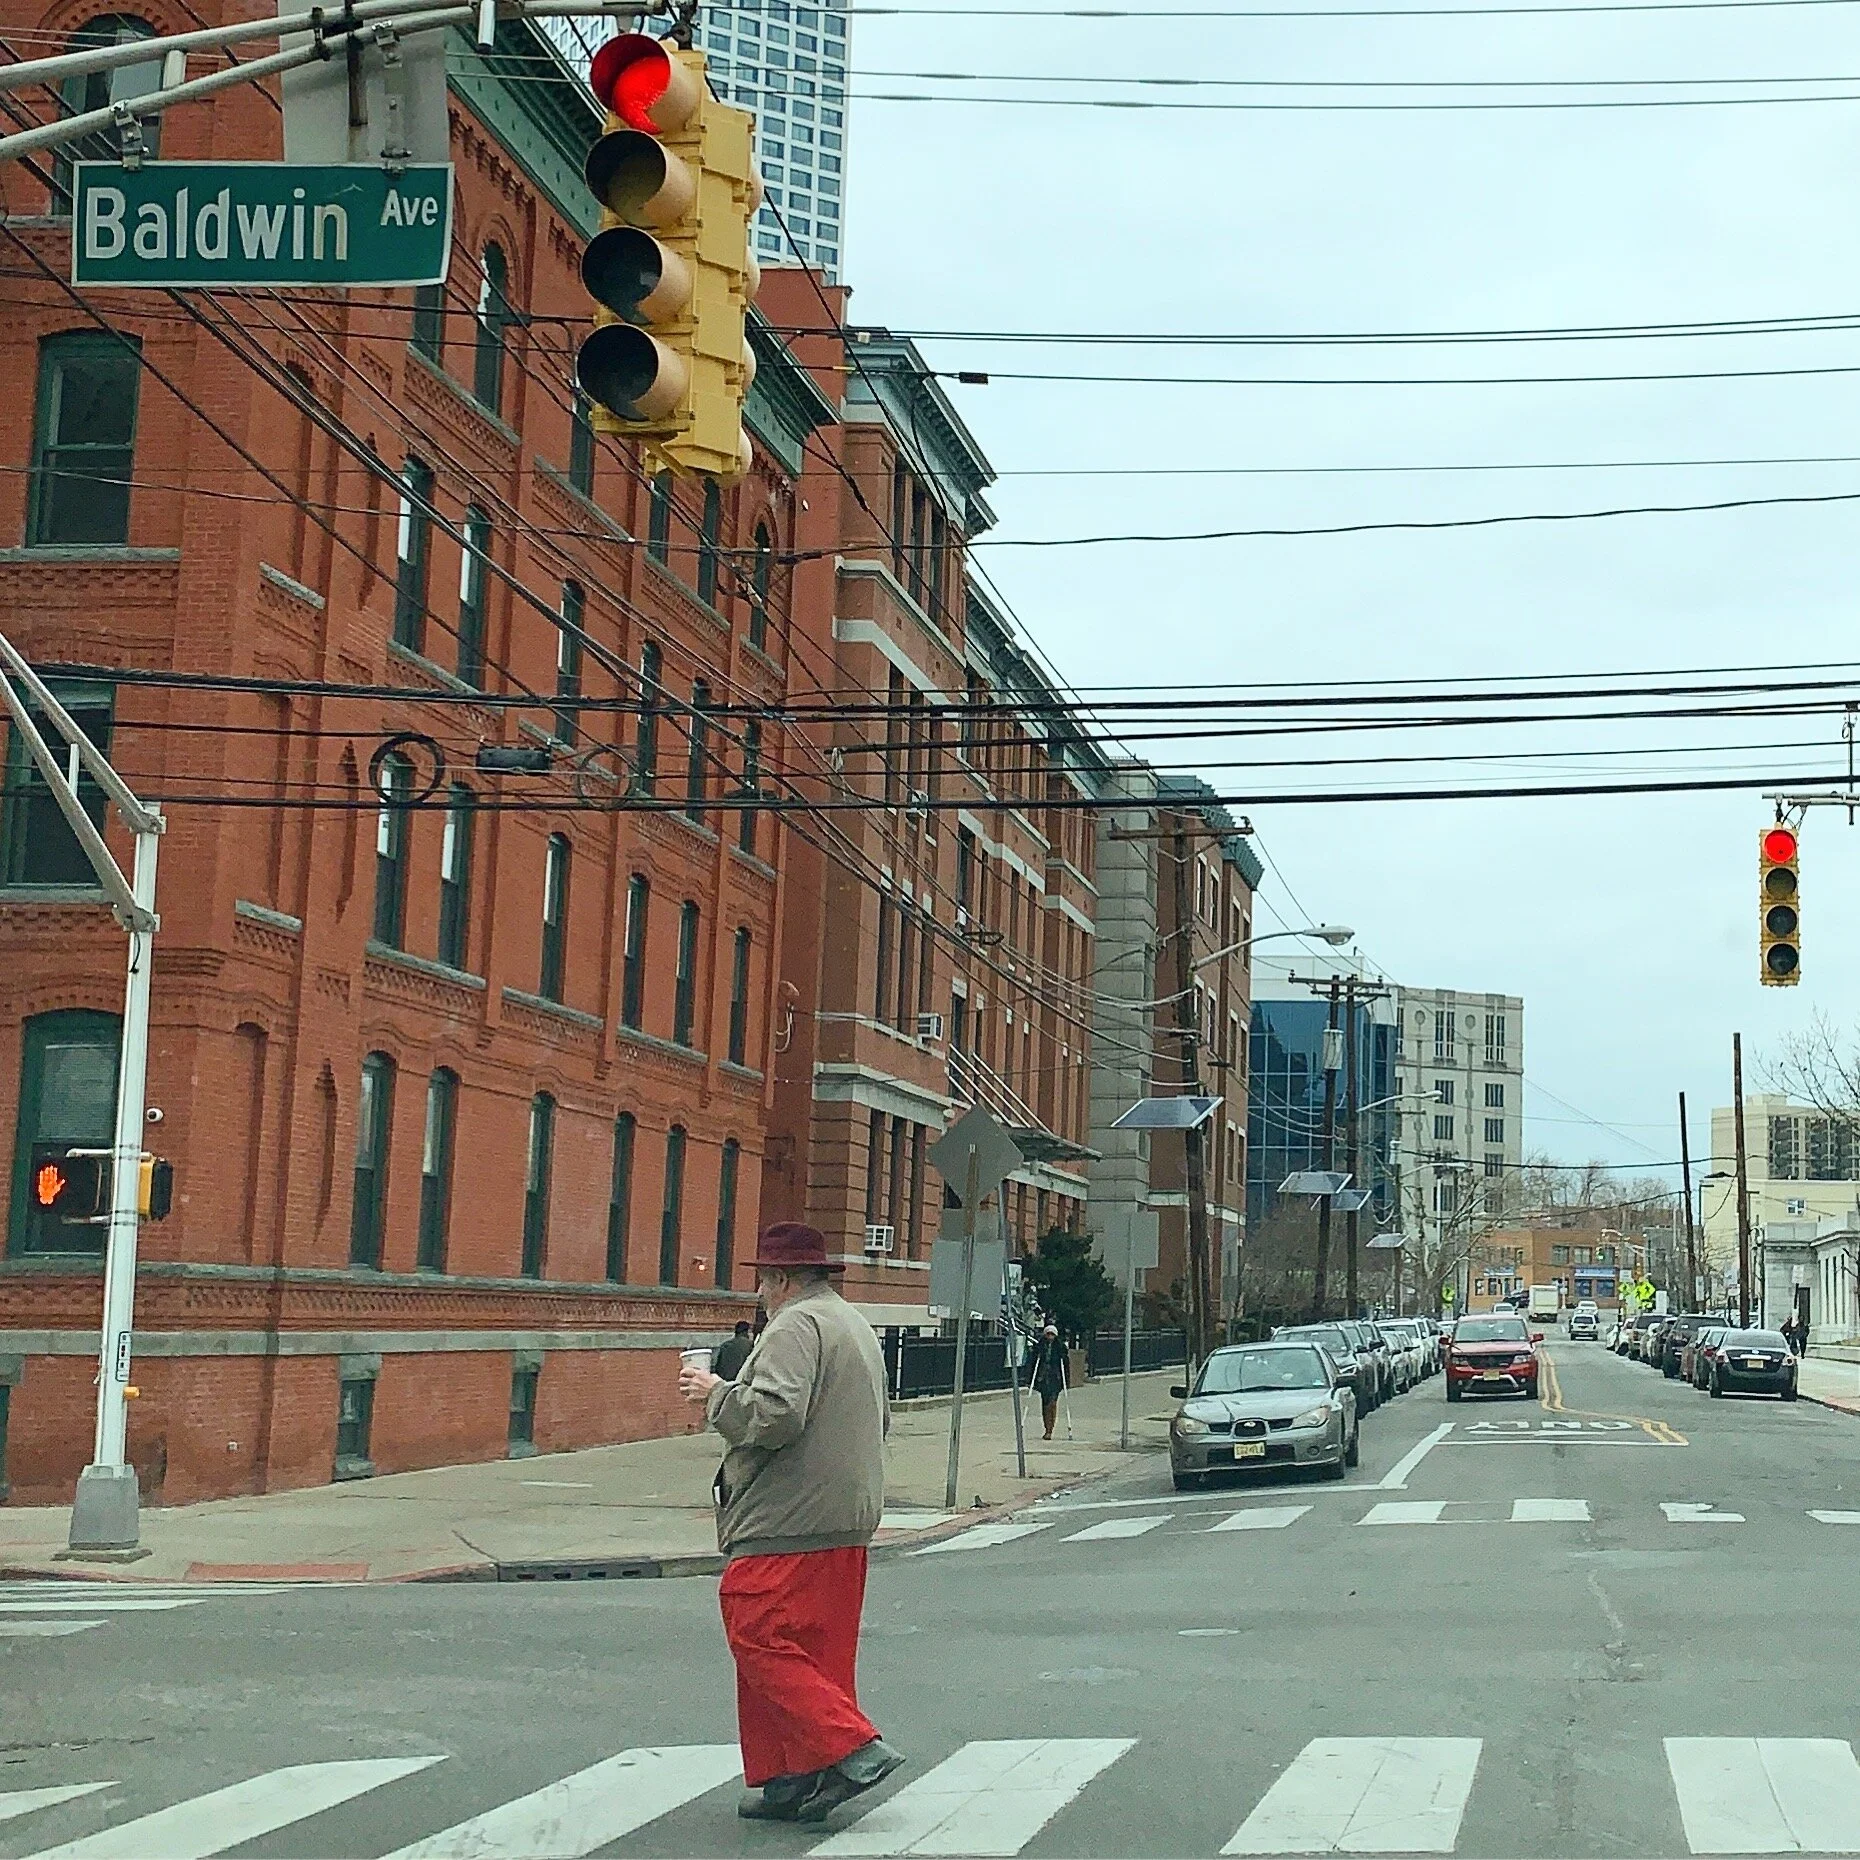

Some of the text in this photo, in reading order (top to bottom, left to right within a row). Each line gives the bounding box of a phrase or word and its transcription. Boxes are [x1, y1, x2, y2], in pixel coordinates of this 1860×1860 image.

[85, 186, 438, 261] Baldwin Ave
[1464, 1421, 1633, 1430] ONLY
